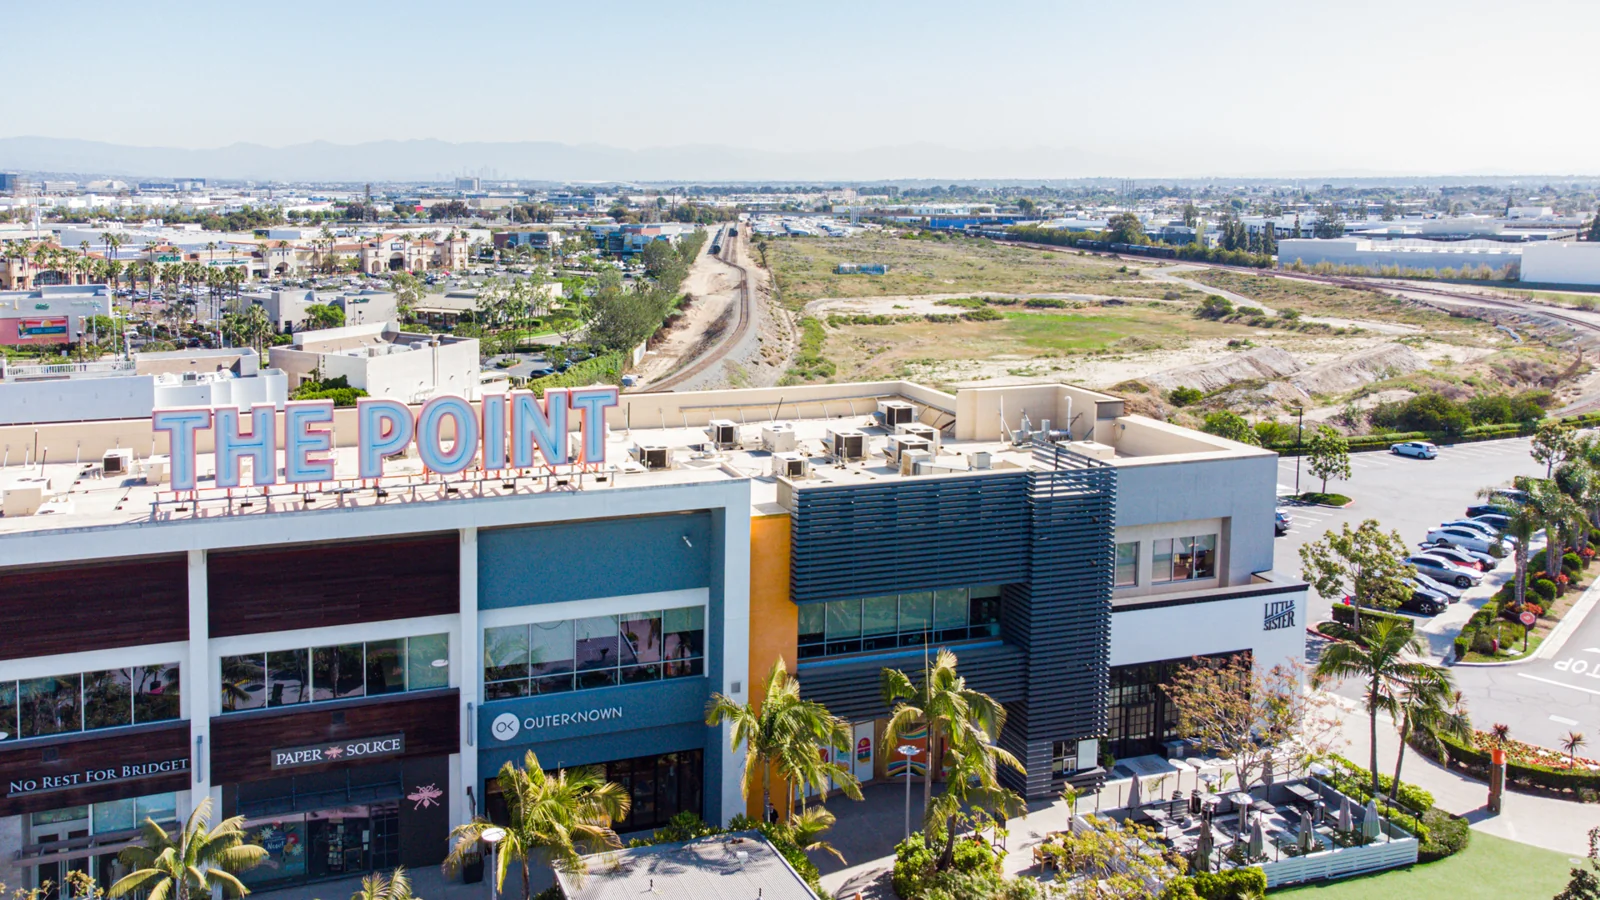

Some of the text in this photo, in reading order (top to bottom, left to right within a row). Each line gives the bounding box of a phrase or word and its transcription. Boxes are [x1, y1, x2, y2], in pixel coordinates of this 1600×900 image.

[152, 386, 619, 492] THE POINT
[1264, 599, 1295, 620] LITTLE
[1263, 610, 1296, 631] SISTER
[1553, 657, 1600, 678] TOP
[276, 738, 401, 766] PAPER SOURCE
